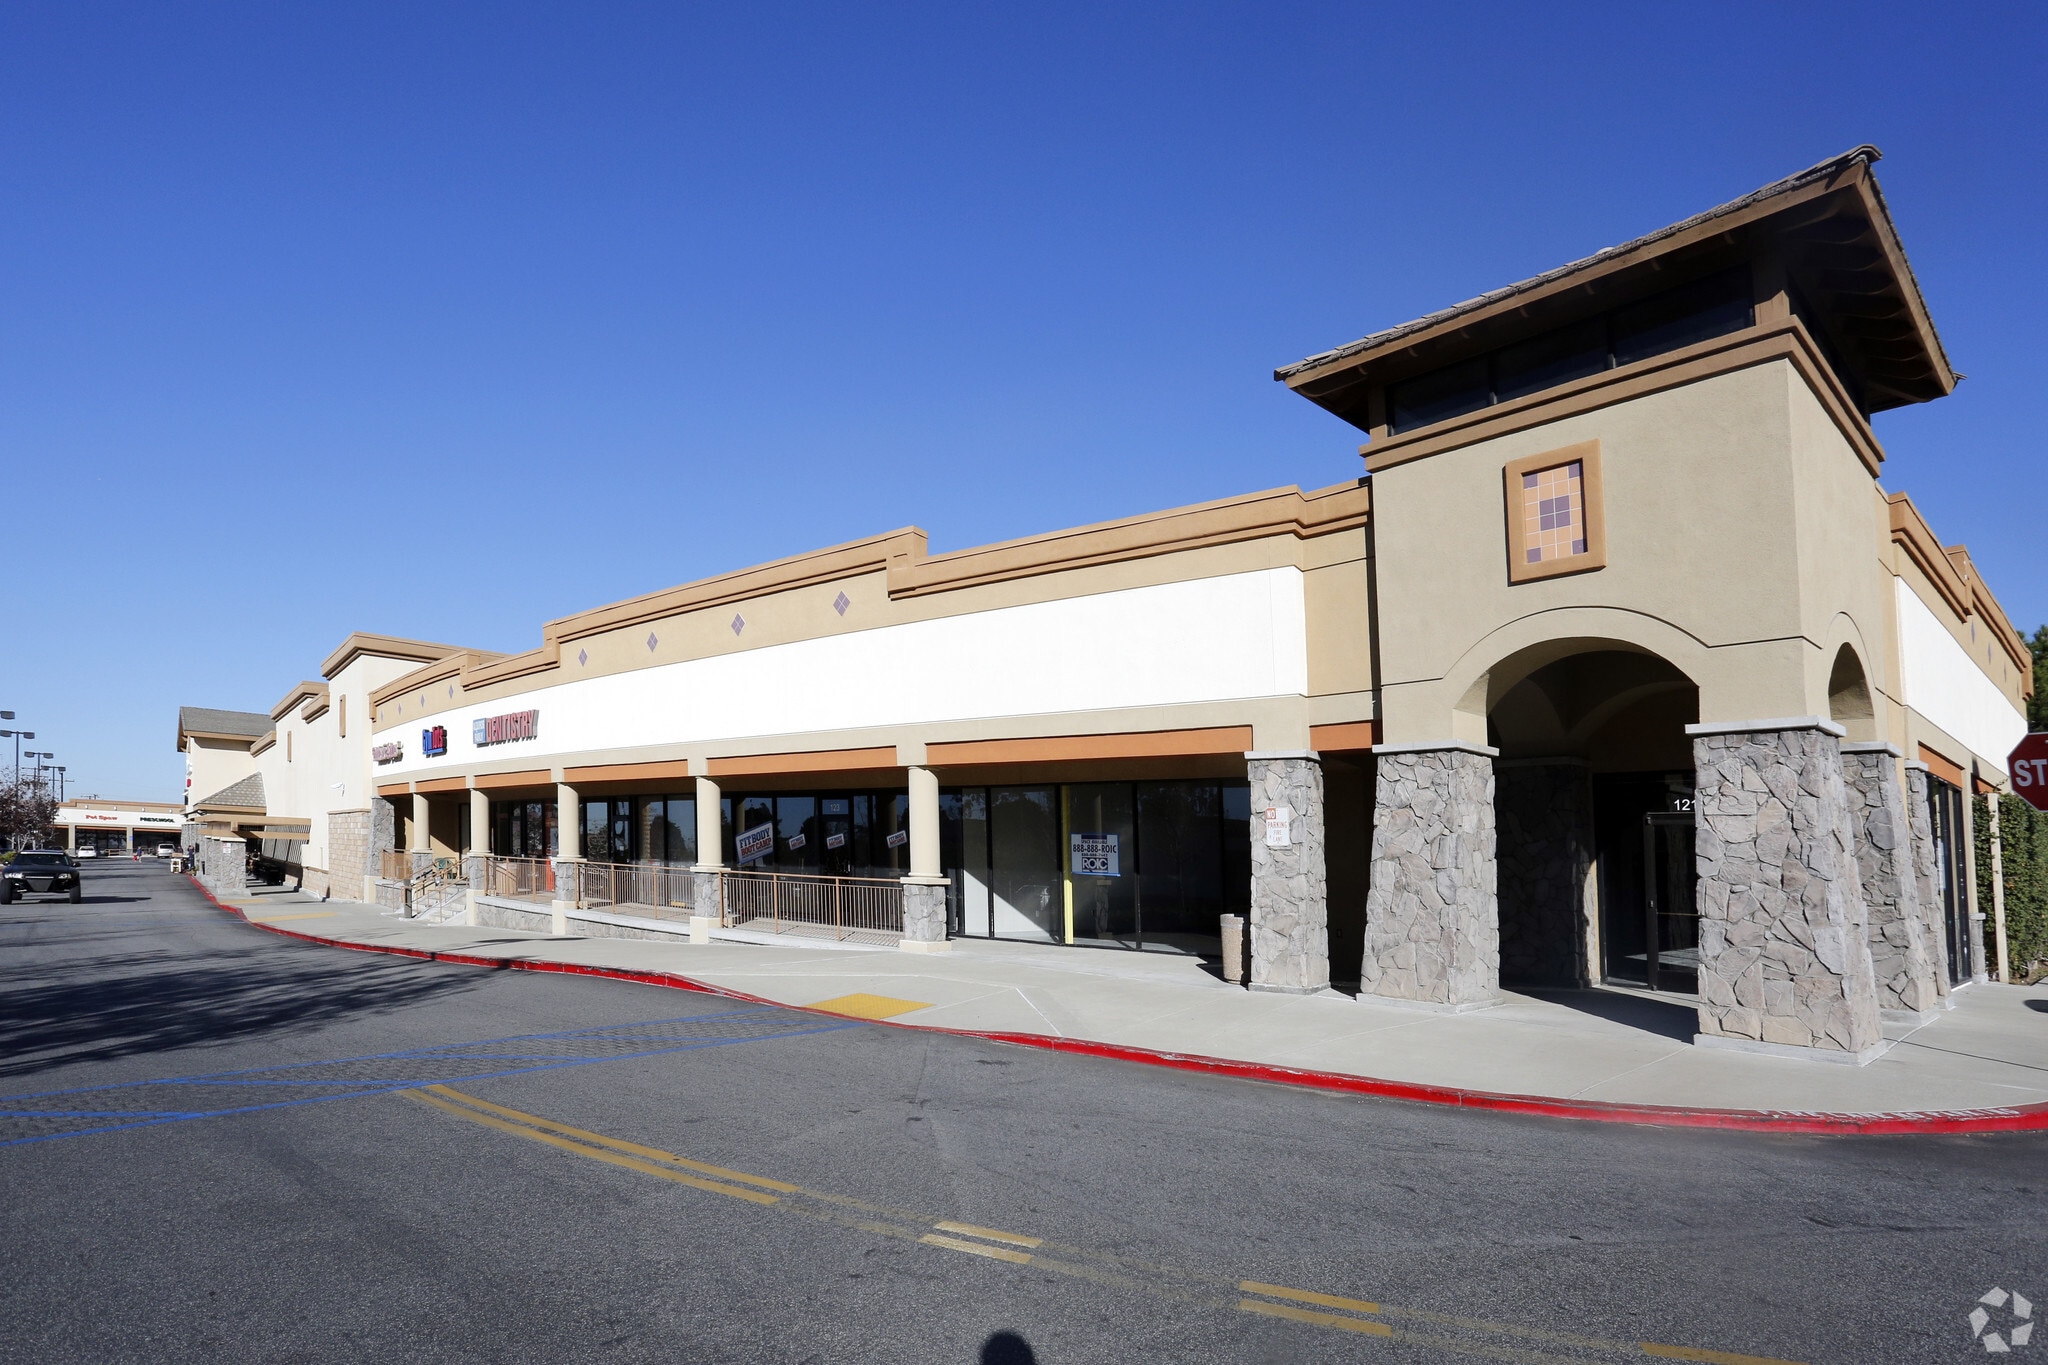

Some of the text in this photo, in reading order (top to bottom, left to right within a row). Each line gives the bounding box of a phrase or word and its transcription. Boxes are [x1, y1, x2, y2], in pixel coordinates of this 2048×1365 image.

[486, 709, 538, 742] DENTISTRY
[1267, 809, 1275, 819] NO
[739, 827, 770, 848] FIT BODY
[740, 843, 756, 856] BOOT
[755, 837, 772, 849] CAMP
[1073, 844, 1117, 853] 888-888-ROIC
[1082, 858, 1108, 870] ROIC
